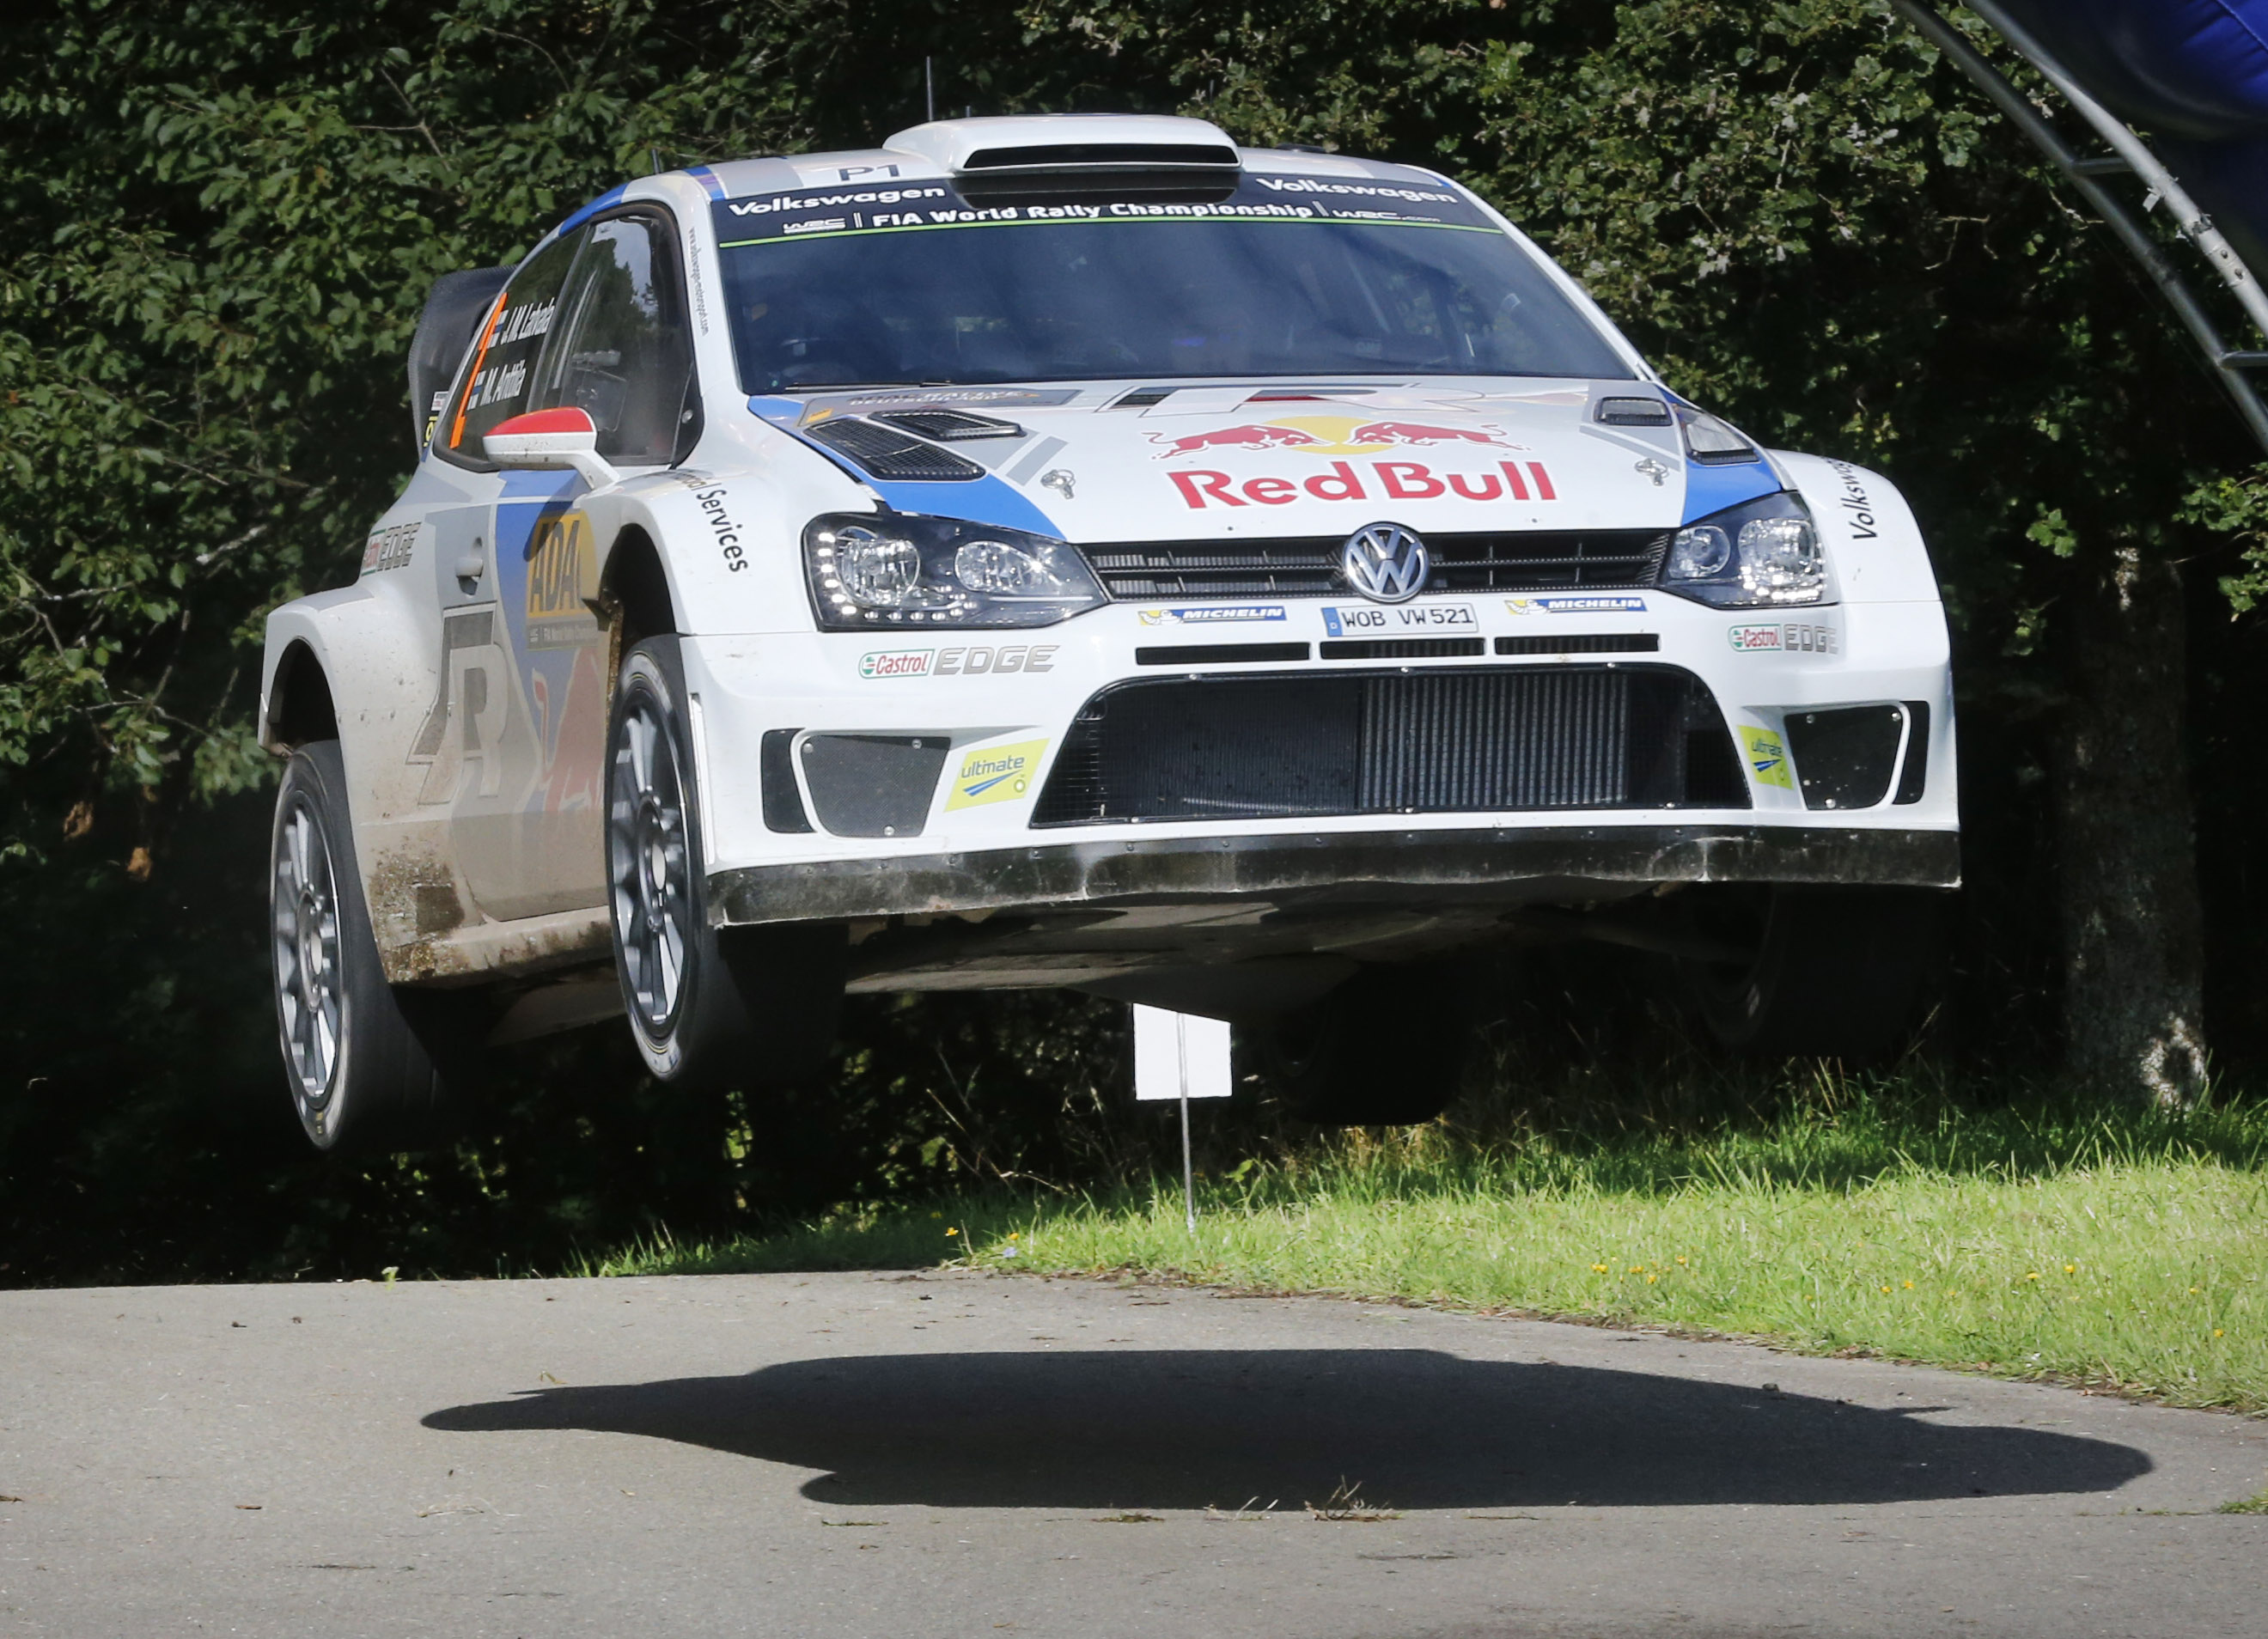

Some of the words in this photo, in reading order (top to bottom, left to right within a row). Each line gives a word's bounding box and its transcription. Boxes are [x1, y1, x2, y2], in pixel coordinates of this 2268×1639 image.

[837, 164, 900, 181] P1
[729, 187, 946, 216] Volkswagen
[1255, 178, 1459, 203] Volkswagen
[783, 217, 847, 234] WRC
[872, 213, 924, 228] FIA
[929, 206, 1019, 222] World
[1027, 204, 1101, 219] Rally
[1109, 203, 1314, 218] Championship
[1168, 460, 1367, 509] Red
[1371, 460, 1557, 501] Bull
[696, 489, 749, 572] Services
[1181, 608, 1283, 619] MICHELIN
[1341, 611, 1387, 628] WOB
[1397, 609, 1425, 625] VW
[1430, 608, 1474, 625] 521
[1548, 600, 1643, 609] MICHELIN
[1744, 628, 1781, 647] Castrol
[1783, 624, 1839, 655] EDGE
[876, 653, 929, 674] Castrol
[933, 645, 1060, 675] EDGE
[960, 755, 1026, 778] ultimate
